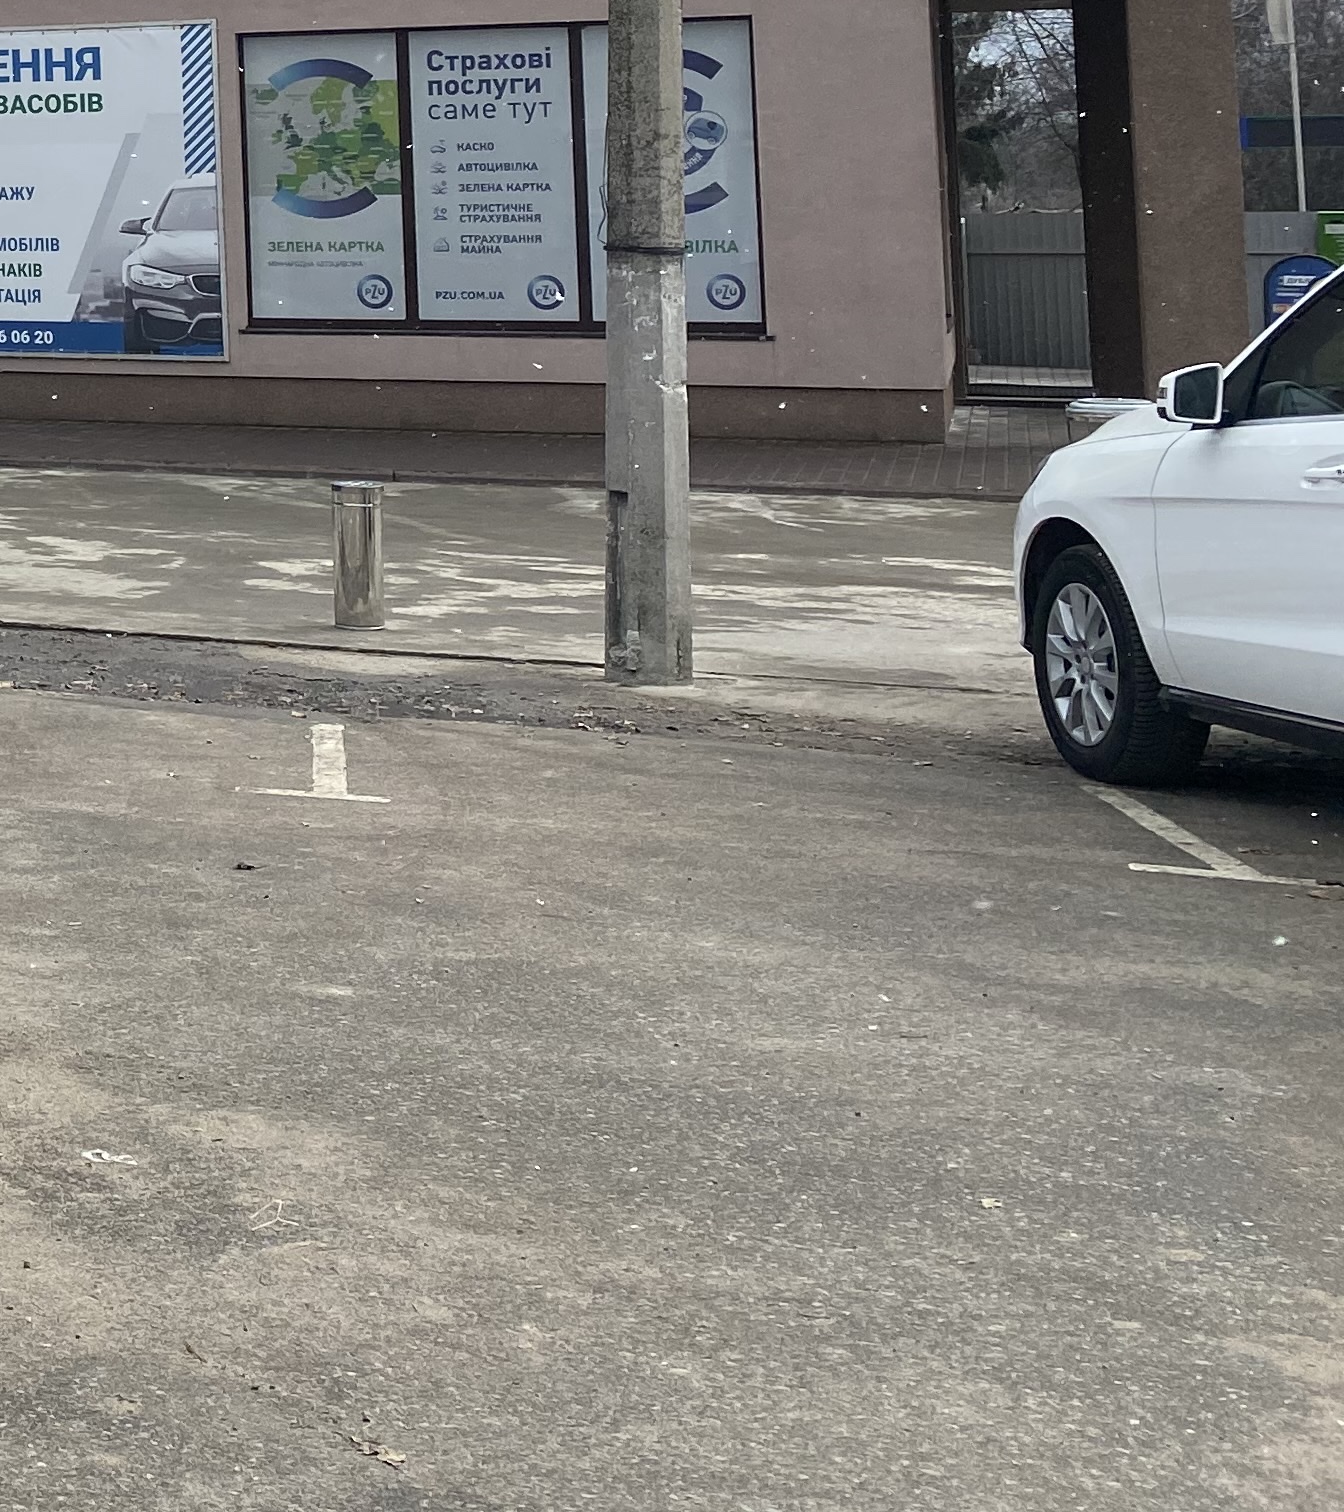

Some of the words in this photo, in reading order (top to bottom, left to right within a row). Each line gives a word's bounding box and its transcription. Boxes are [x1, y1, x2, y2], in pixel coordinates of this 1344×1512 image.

[426, 46, 552, 76] Страхові
[427, 77, 542, 100] послуги
[428, 101, 497, 120] саме
[507, 101, 552, 124] тут
[457, 142, 495, 152] КАСКО
[457, 162, 538, 173] АВТОЦИВІЛКА
[458, 183, 503, 192] ЗЕЛЕНА
[506, 182, 552, 192] КАРТКА
[459, 203, 533, 213] ТУРИСТИЧНЕ
[459, 213, 541, 223] СТРАХУВАННЯ
[460, 234, 542, 244] СТРАХУВАННЯ
[267, 241, 324, 252] ЗЕЛЕНА
[328, 241, 384, 252] КАРТКА
[364, 284, 385, 300] PZU
[435, 290, 505, 300] PZU.COM.UA
[535, 285, 557, 300] PZU
[715, 284, 737, 300] PZU
[11, 330, 30, 344] 06
[34, 330, 53, 345] 20
